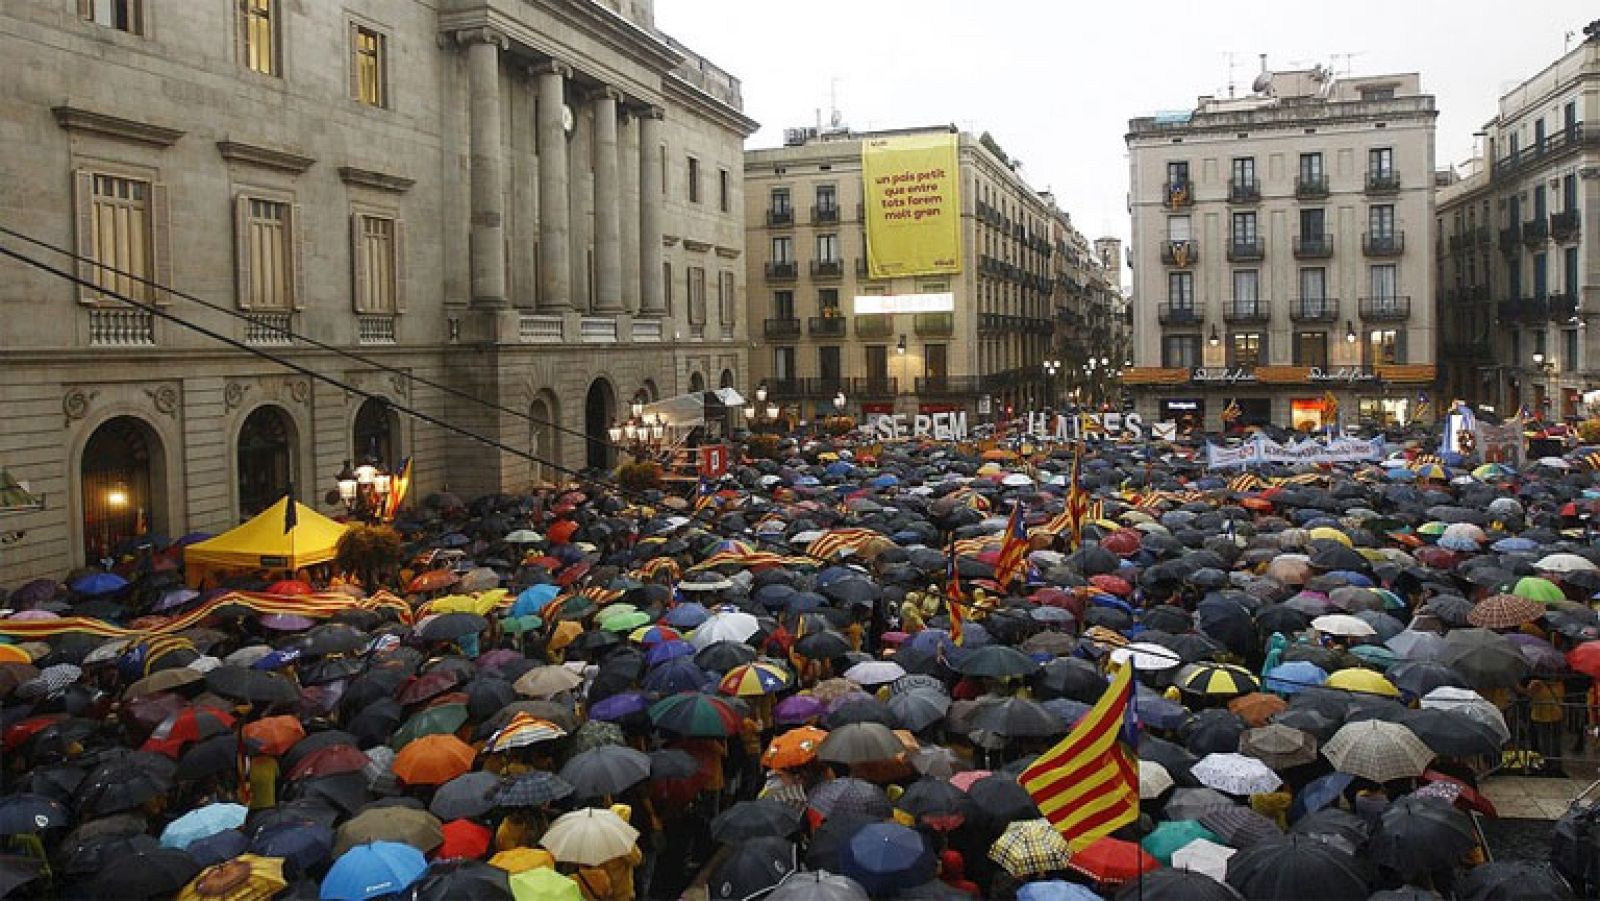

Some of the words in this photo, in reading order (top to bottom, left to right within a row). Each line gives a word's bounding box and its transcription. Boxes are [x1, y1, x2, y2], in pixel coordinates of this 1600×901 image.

[917, 169, 945, 182] petit
[885, 188, 904, 198] que
[908, 184, 937, 192] entre
[882, 199, 904, 208] tots
[885, 208, 911, 219] molt
[915, 208, 940, 219] gran
